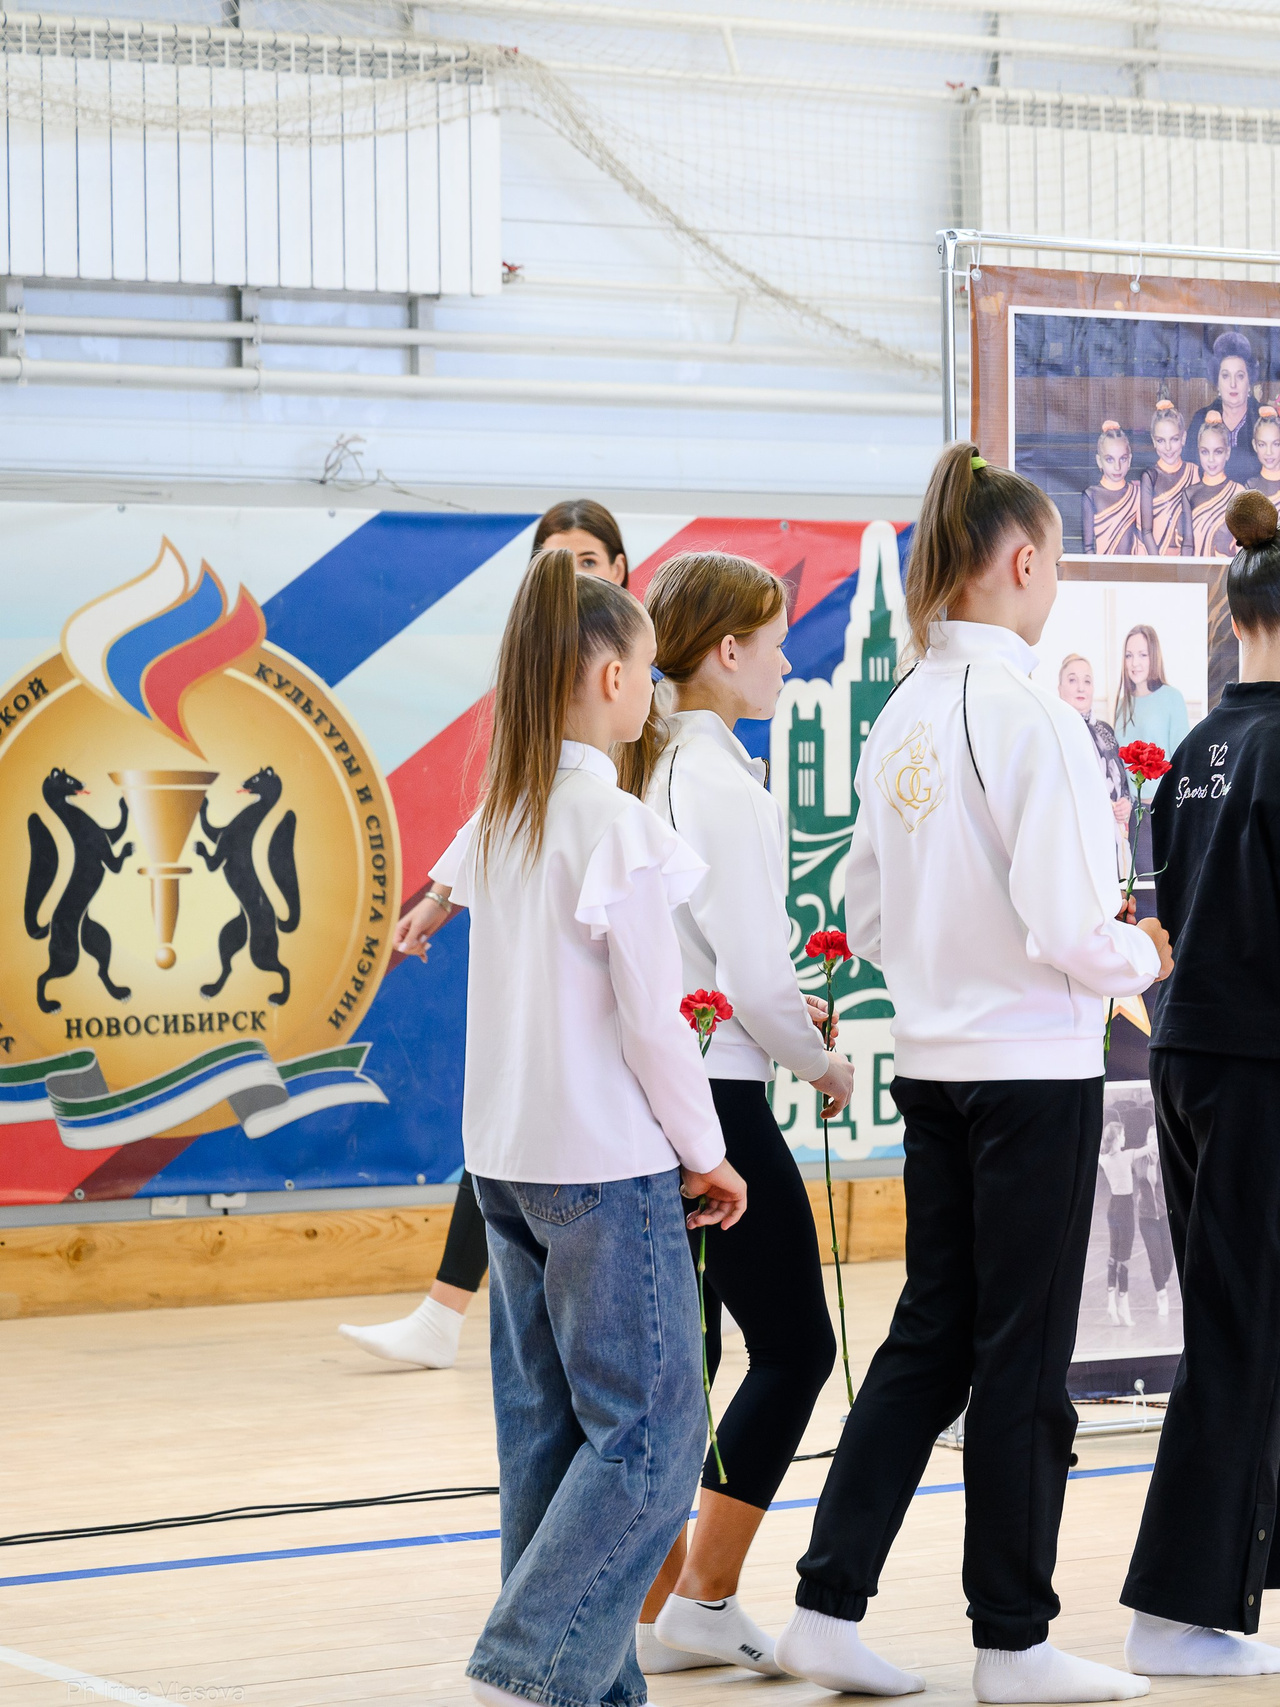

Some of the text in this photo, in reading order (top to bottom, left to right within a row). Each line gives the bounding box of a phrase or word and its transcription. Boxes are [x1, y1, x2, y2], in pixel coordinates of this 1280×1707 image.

[0, 661, 387, 1031] КОЙ КУЛЬТУРЫ И СПОРТА МЭРИИ
[65, 1011, 266, 1040] НОВОСИБИРСК
